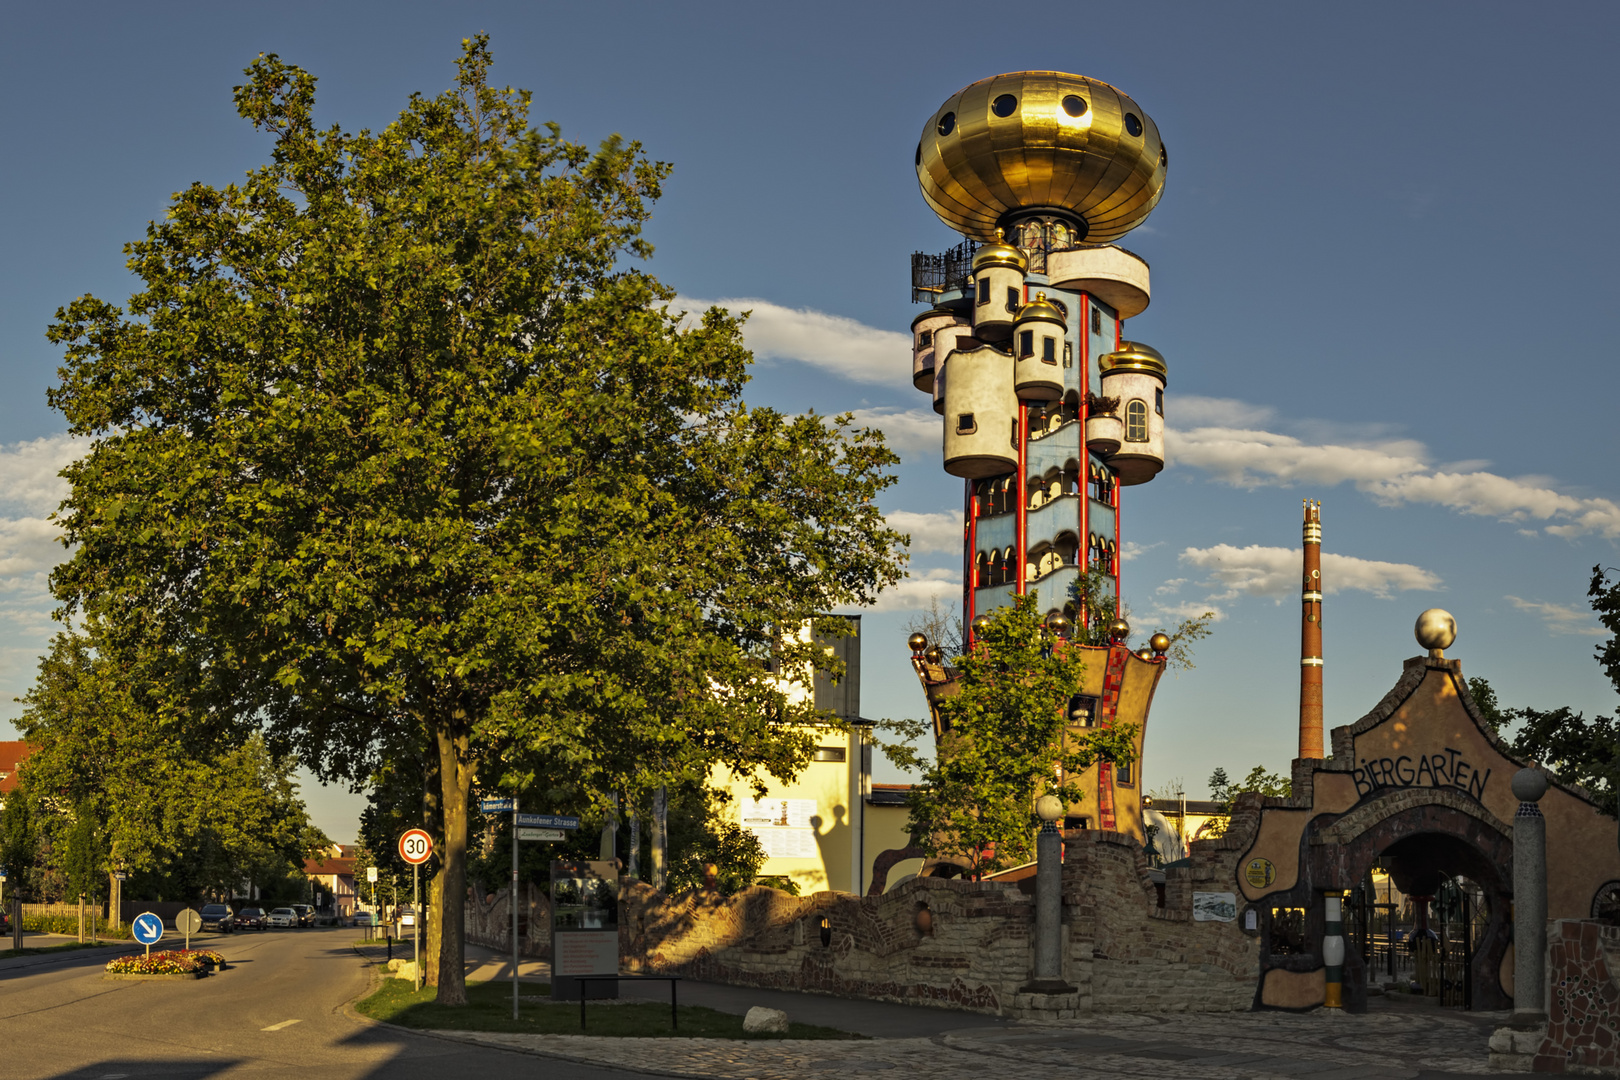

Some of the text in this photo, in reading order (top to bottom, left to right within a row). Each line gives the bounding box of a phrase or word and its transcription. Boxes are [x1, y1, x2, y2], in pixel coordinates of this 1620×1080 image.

[519, 816, 577, 827] Aunkofener Strasse
[406, 839, 425, 854] 30
